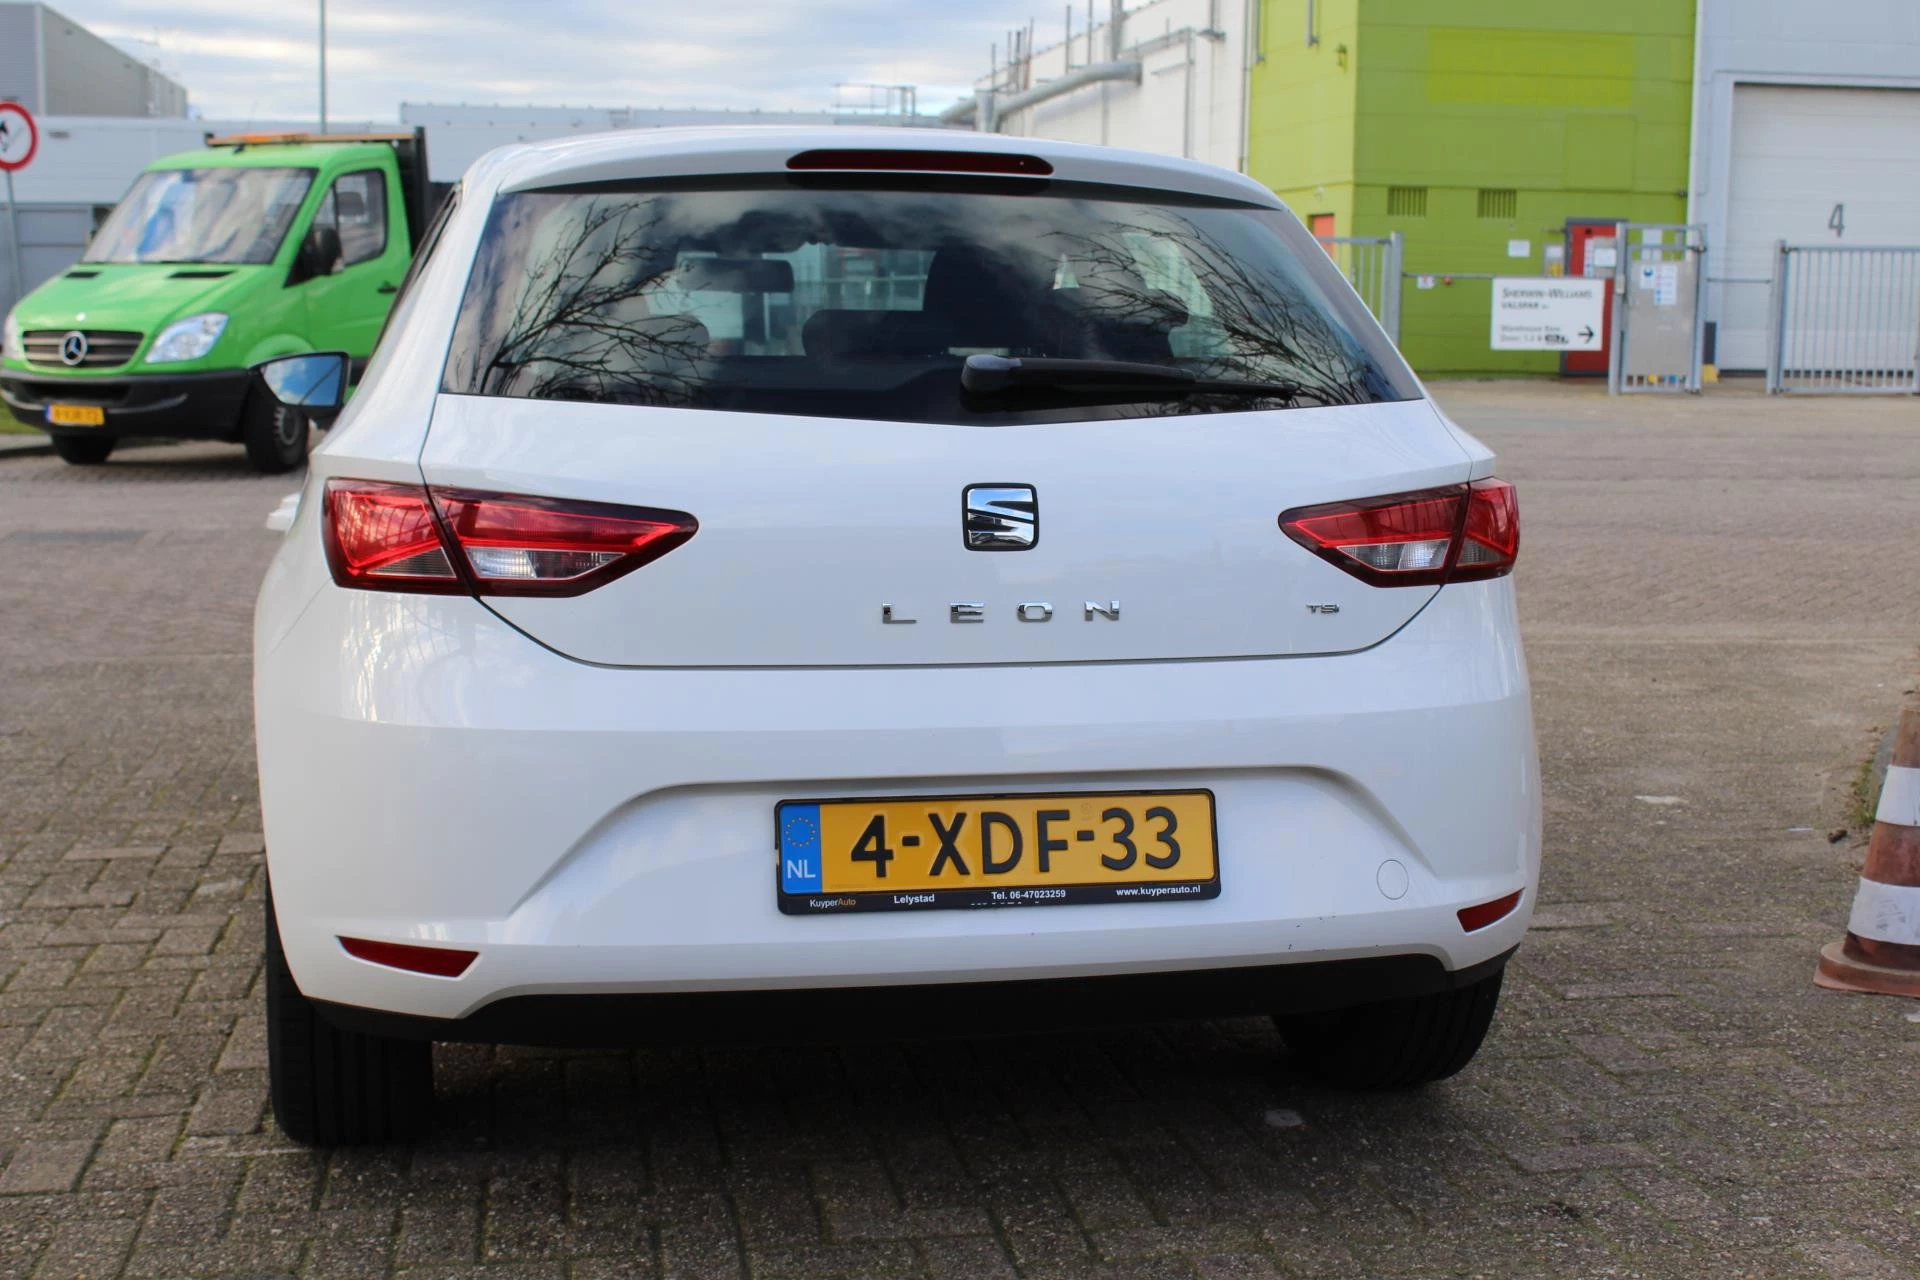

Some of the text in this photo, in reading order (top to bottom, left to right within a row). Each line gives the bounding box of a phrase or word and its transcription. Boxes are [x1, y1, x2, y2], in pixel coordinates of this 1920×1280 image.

[1828, 203, 1846, 238] 4
[882, 600, 1120, 625] LEON
[786, 806, 1182, 879] NL 4-XDF-33
[809, 884, 1201, 909] KuyperAuto Lelystad Tel. 06-47023259 www.kuyperauto.nl
